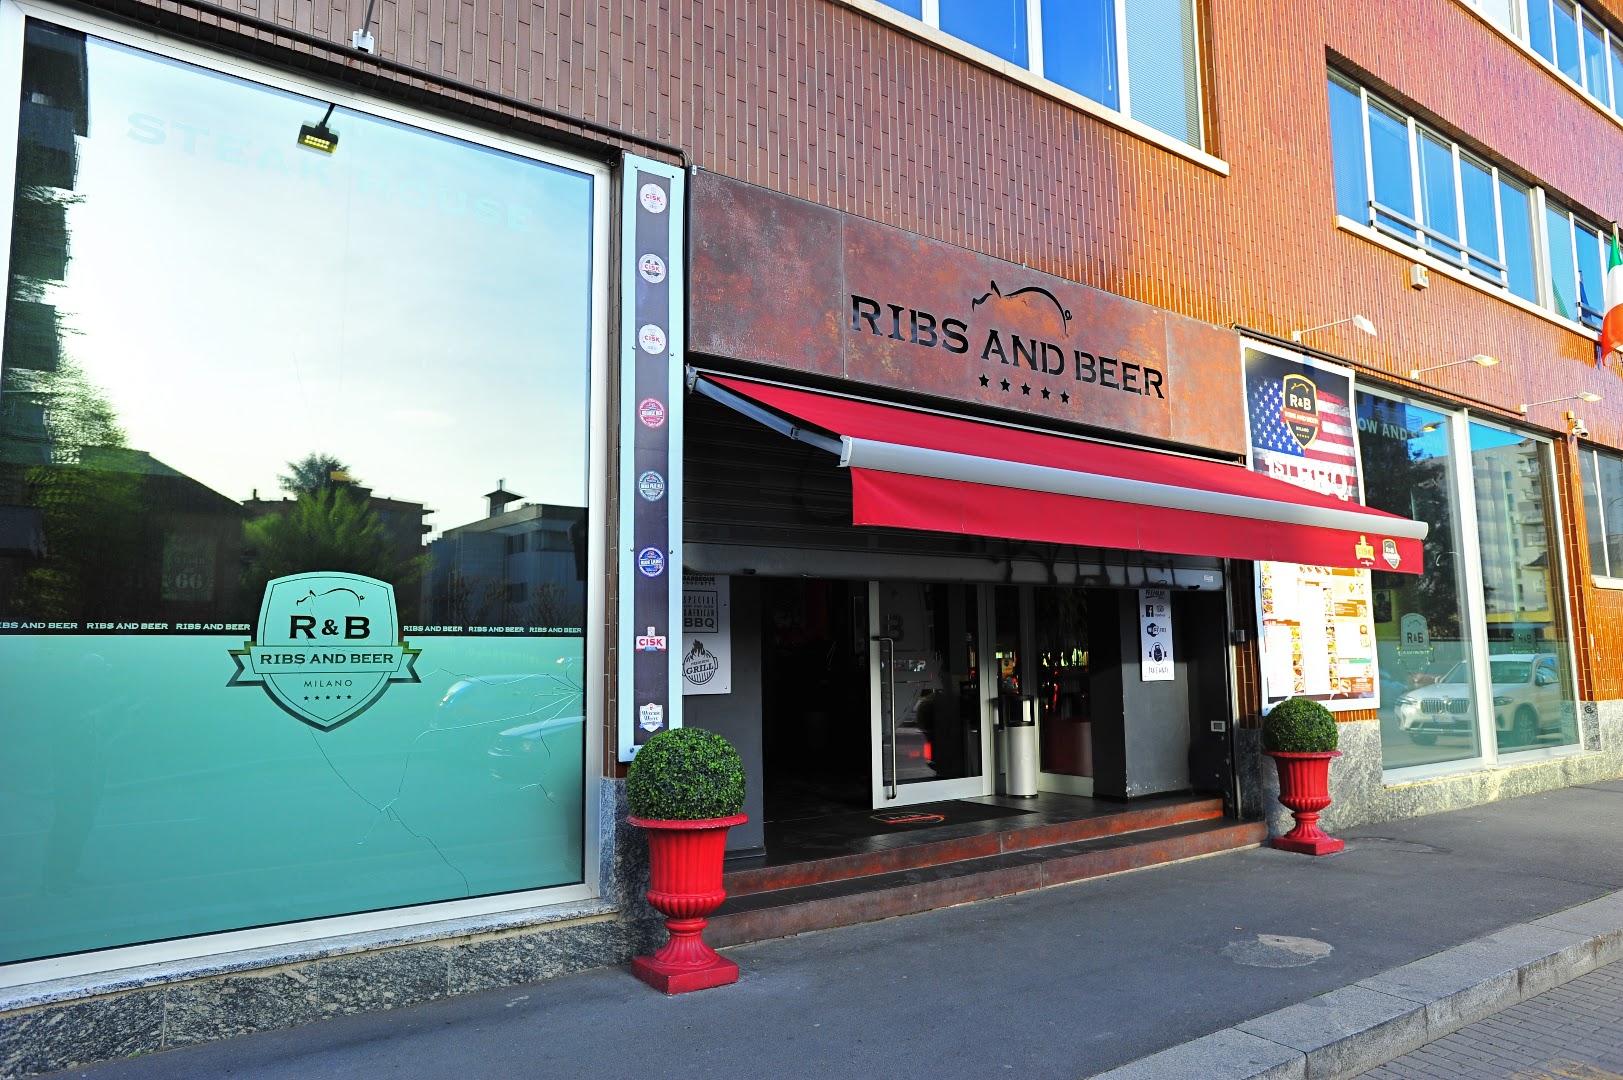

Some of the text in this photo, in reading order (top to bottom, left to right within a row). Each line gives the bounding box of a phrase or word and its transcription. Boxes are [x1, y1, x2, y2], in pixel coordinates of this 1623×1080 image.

[127, 112, 533, 232] STEAK HOUSE
[646, 193, 662, 202] CISK
[645, 264, 660, 272] CISK
[644, 334, 661, 343] CISK
[851, 294, 1165, 400] RIBS AND BEER
[1289, 393, 1311, 411] R&B
[1382, 423, 1408, 441] AND
[21, 622, 46, 630] AND
[48, 622, 79, 630] BEER
[86, 622, 169, 630] RIBS AND BEER
[203, 623, 224, 631] AND
[225, 623, 251, 631] BEER
[289, 614, 371, 640] R&B
[684, 617, 715, 629] BBQ
[639, 638, 663, 647] CISK
[1407, 632, 1425, 643] R&B
[260, 653, 394, 664] RIBS AND BEER
[686, 662, 714, 675] GRILL
[303, 679, 353, 688] MILANO
